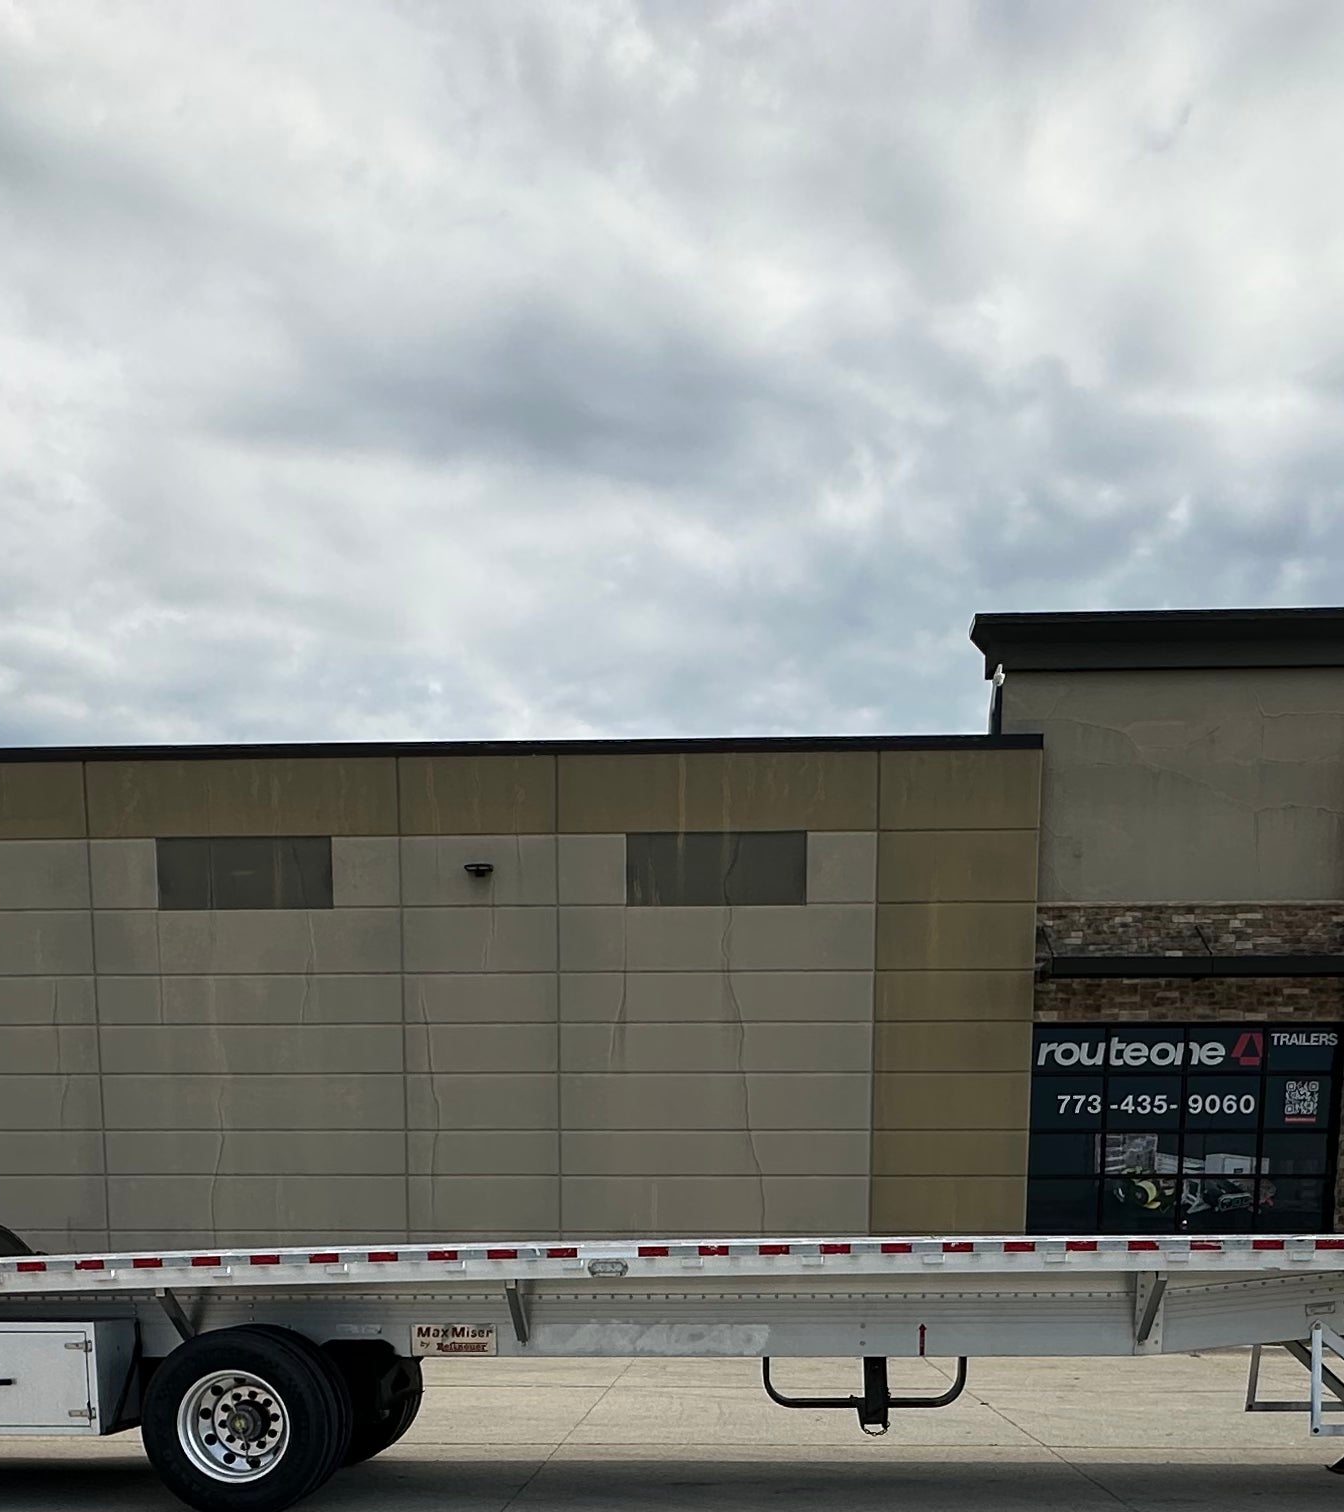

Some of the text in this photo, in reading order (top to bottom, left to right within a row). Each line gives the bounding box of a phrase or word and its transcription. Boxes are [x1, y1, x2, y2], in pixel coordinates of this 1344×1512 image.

[1271, 1033, 1339, 1047] TRAILERS
[1037, 1036, 1226, 1067] routeone
[417, 1326, 494, 1338] Max Miser
